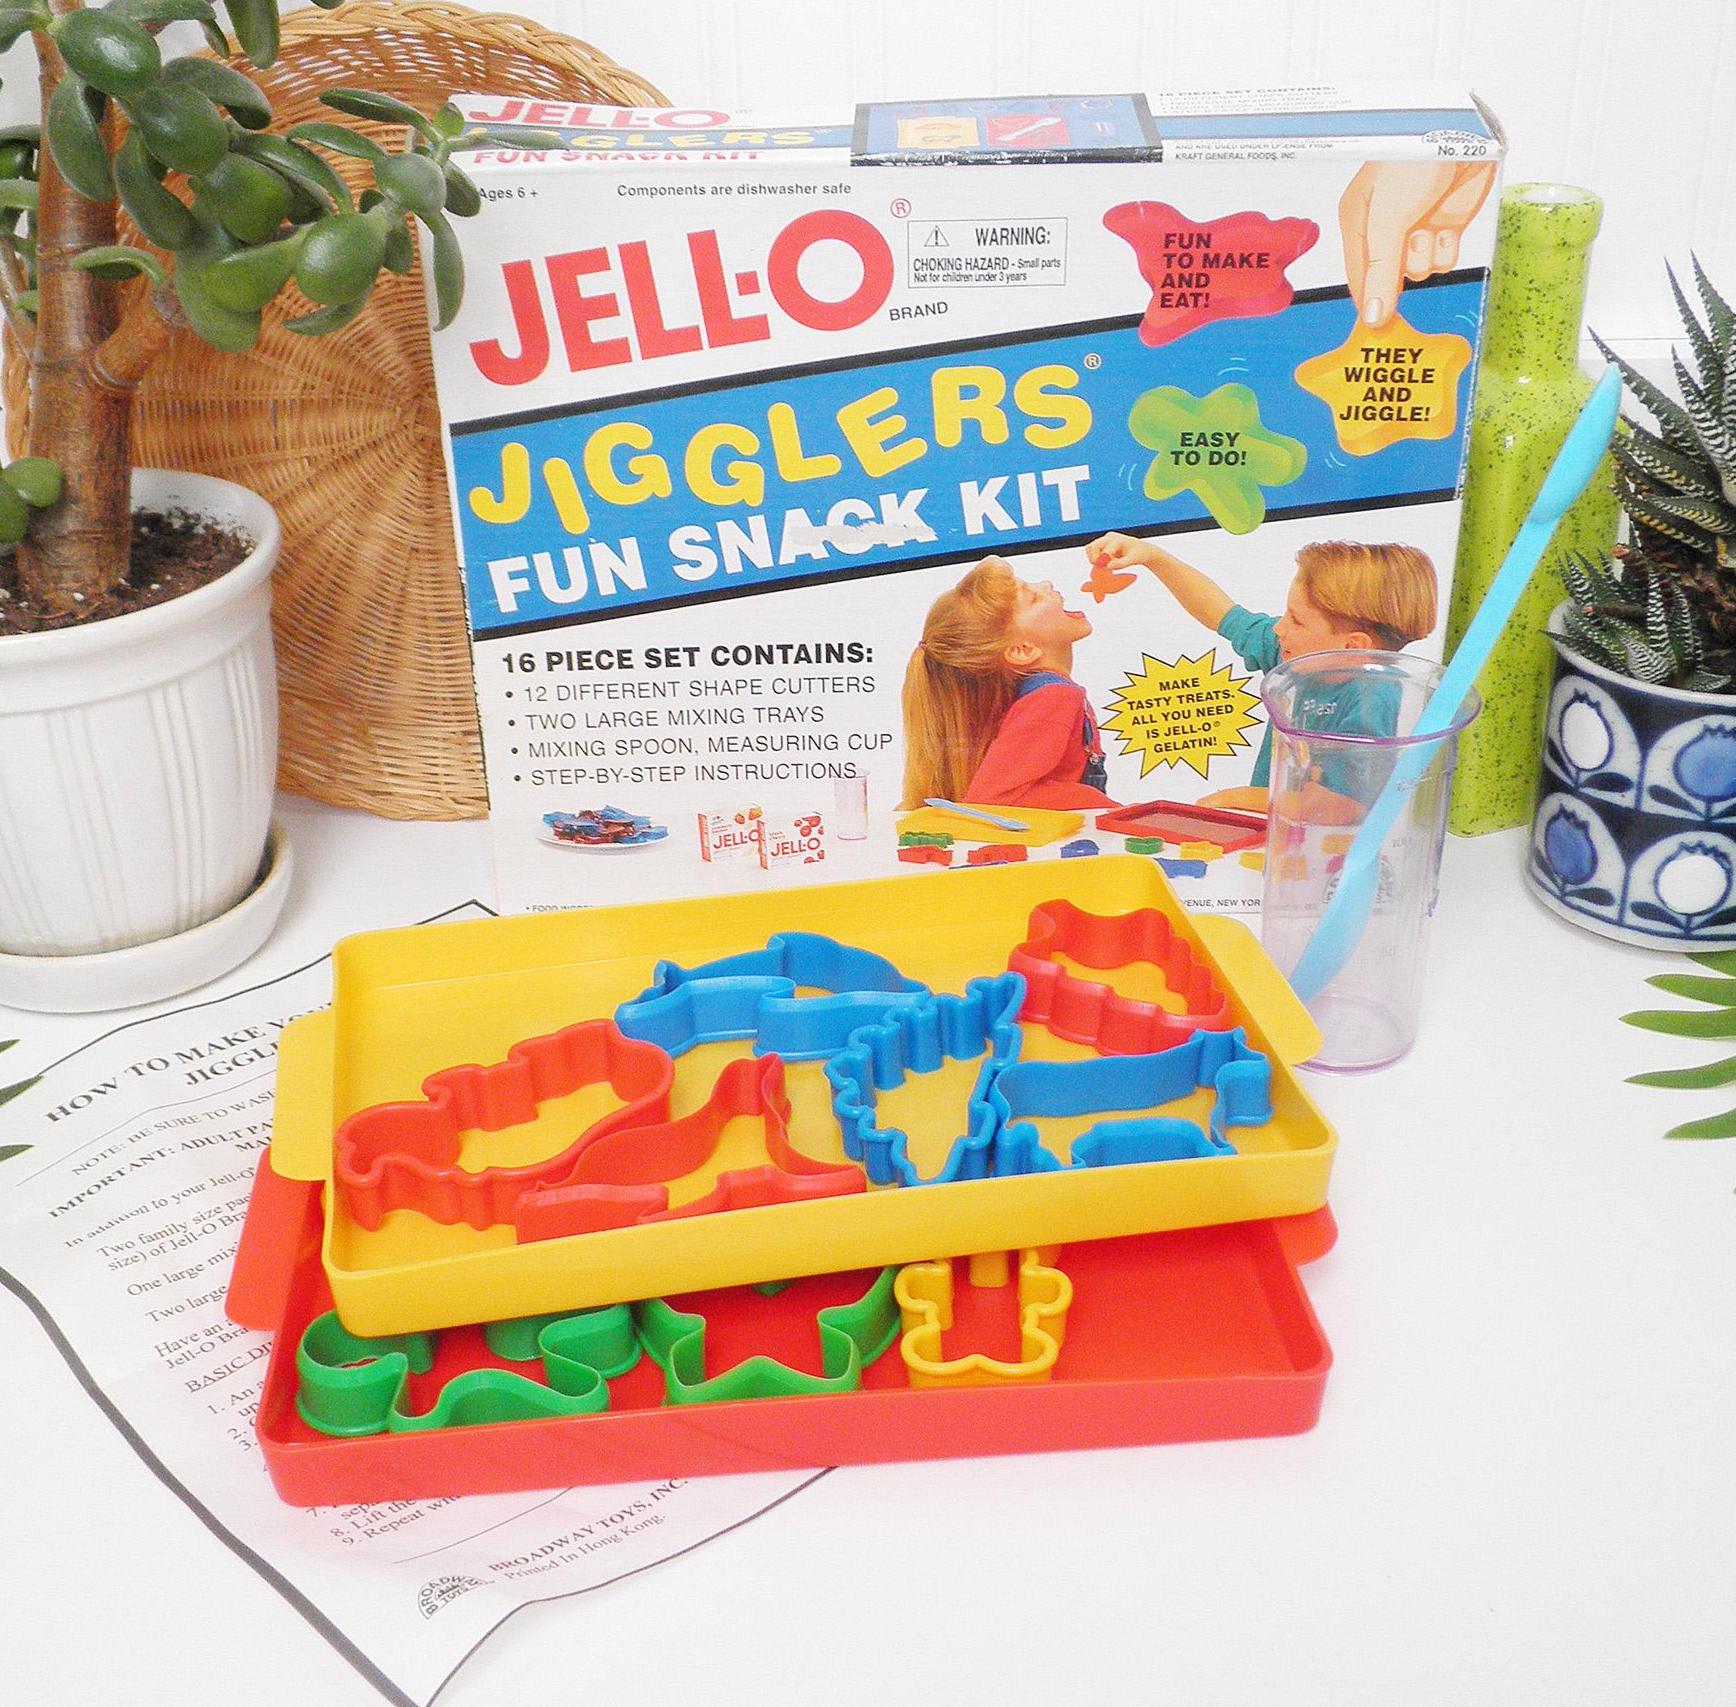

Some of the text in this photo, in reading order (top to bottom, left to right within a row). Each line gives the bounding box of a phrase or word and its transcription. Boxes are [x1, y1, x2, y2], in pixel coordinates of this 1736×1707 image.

[469, 100, 731, 129] JELL-O
[474, 150, 548, 164] FUN
[1175, 152, 1203, 161] KRAFT
[1205, 152, 1244, 160] GENERAL
[1438, 145, 1487, 156] No. 220
[479, 187, 513, 201] Ages
[517, 186, 526, 198] 6
[617, 183, 852, 199] Components are dishwasher safe
[975, 226, 1051, 247] WARNING:
[1163, 233, 1212, 250] FUN
[913, 257, 962, 272] CHOKING
[965, 256, 1010, 271] HAZARD
[1017, 257, 1040, 269] Small
[1041, 257, 1062, 271] parts
[1162, 252, 1270, 269] TO MAKE
[914, 270, 1027, 284] Not for children under 3 years
[1160, 272, 1211, 289] AND
[469, 209, 894, 386] JELL-O
[1160, 292, 1211, 309] EAT!
[889, 301, 949, 321] BRAND
[1360, 348, 1423, 364] THEY
[1344, 367, 1435, 384] WIGGLE
[1362, 387, 1412, 403] AND
[1339, 406, 1430, 422] JIGGLE!
[468, 364, 1093, 535] JIGGLERS
[1180, 432, 1241, 448] EASY
[1170, 450, 1247, 466] TO DO!
[487, 464, 1092, 613] FUN SNACK KIT
[503, 642, 873, 673] 16 PIECE SET CONTAINS:
[525, 676, 876, 702] 12 DIFFERENT SHAPE CUTTERS
[1159, 678, 1200, 692] MAKE
[1128, 689, 1235, 711] TASTY TREATS.
[525, 705, 825, 730] TWO LARGE MIXING TRAYS
[1131, 704, 1234, 726] ALL YOU NEED
[1146, 722, 1212, 739] IS JELL-O
[528, 733, 893, 758] MIXING SPOON, MEASURING CUP
[1153, 737, 1217, 753] GELATIN!
[531, 762, 857, 786] STEP-BY-STEP INSTRUCTIONS
[1184, 899, 1261, 907] ENUE, NEW YOR
[45, 1026, 266, 1123] HOW TO MAKE
[184, 1041, 279, 1086] JIGGL
[72, 1144, 127, 1175] NOTE:
[128, 1128, 153, 1143] BE
[154, 1114, 201, 1132] SURE
[202, 1108, 228, 1120] TO
[48, 1129, 242, 1218] IMPORTANT: ADULT
[65, 1237, 83, 1248] In
[87, 1205, 150, 1239] addition
[151, 1198, 168, 1209] to
[171, 1184, 208, 1204] your
[96, 1240, 135, 1257] Two
[138, 1221, 187, 1246] family
[192, 1205, 223, 1225] size
[108, 1251, 148, 1271] size)
[150, 1243, 168, 1257] of
[171, 1223, 217, 1250] Jell-O
[127, 1278, 162, 1296] One
[163, 1263, 205, 1284] large
[145, 1286, 228, 1322] Two large
[154, 1333, 200, 1357] Have
[203, 1323, 223, 1337] an
[165, 1341, 216, 1369] Jell-O
[185, 1356, 247, 1393] BASIC
[230, 1388, 254, 1405] An
[351, 1510, 387, 1530] Lift
[388, 1499, 417, 1514] the
[363, 1508, 426, 1539] Repeat
[488, 1478, 689, 1572] BROADWAY TOYS, INC.
[504, 1514, 667, 1580] Printed In Hong Kong.
